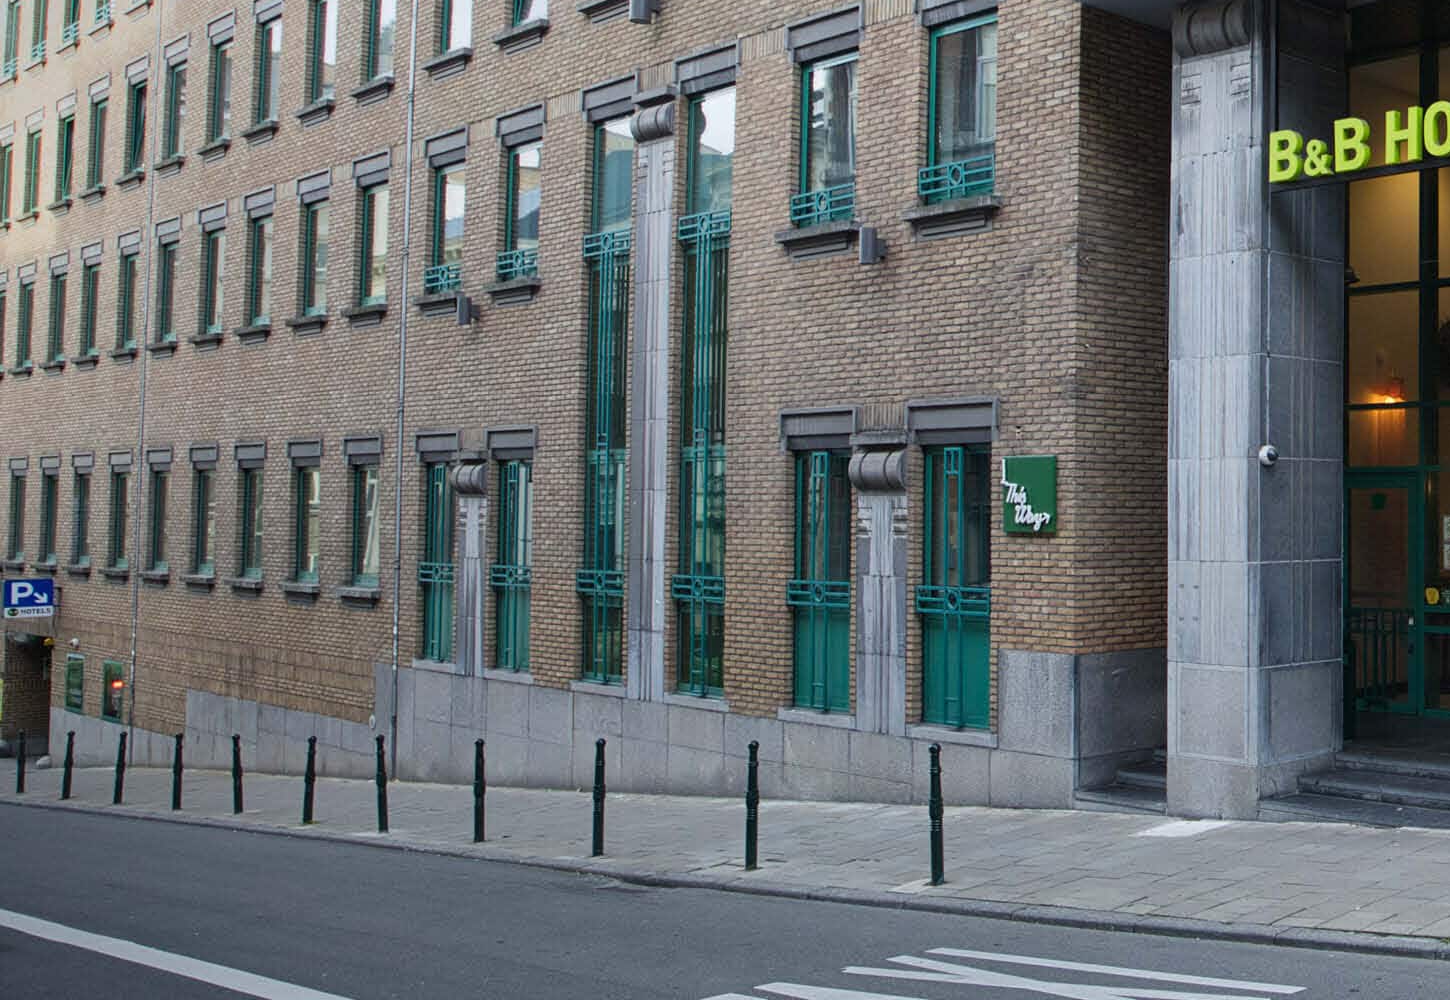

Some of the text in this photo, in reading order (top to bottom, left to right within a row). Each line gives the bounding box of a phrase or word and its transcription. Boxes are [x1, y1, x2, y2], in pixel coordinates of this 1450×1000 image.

[1269, 117, 1371, 184] B&B
[1001, 482, 1027, 503] This
[1015, 504, 1043, 531] Way
[11, 582, 34, 605] P
